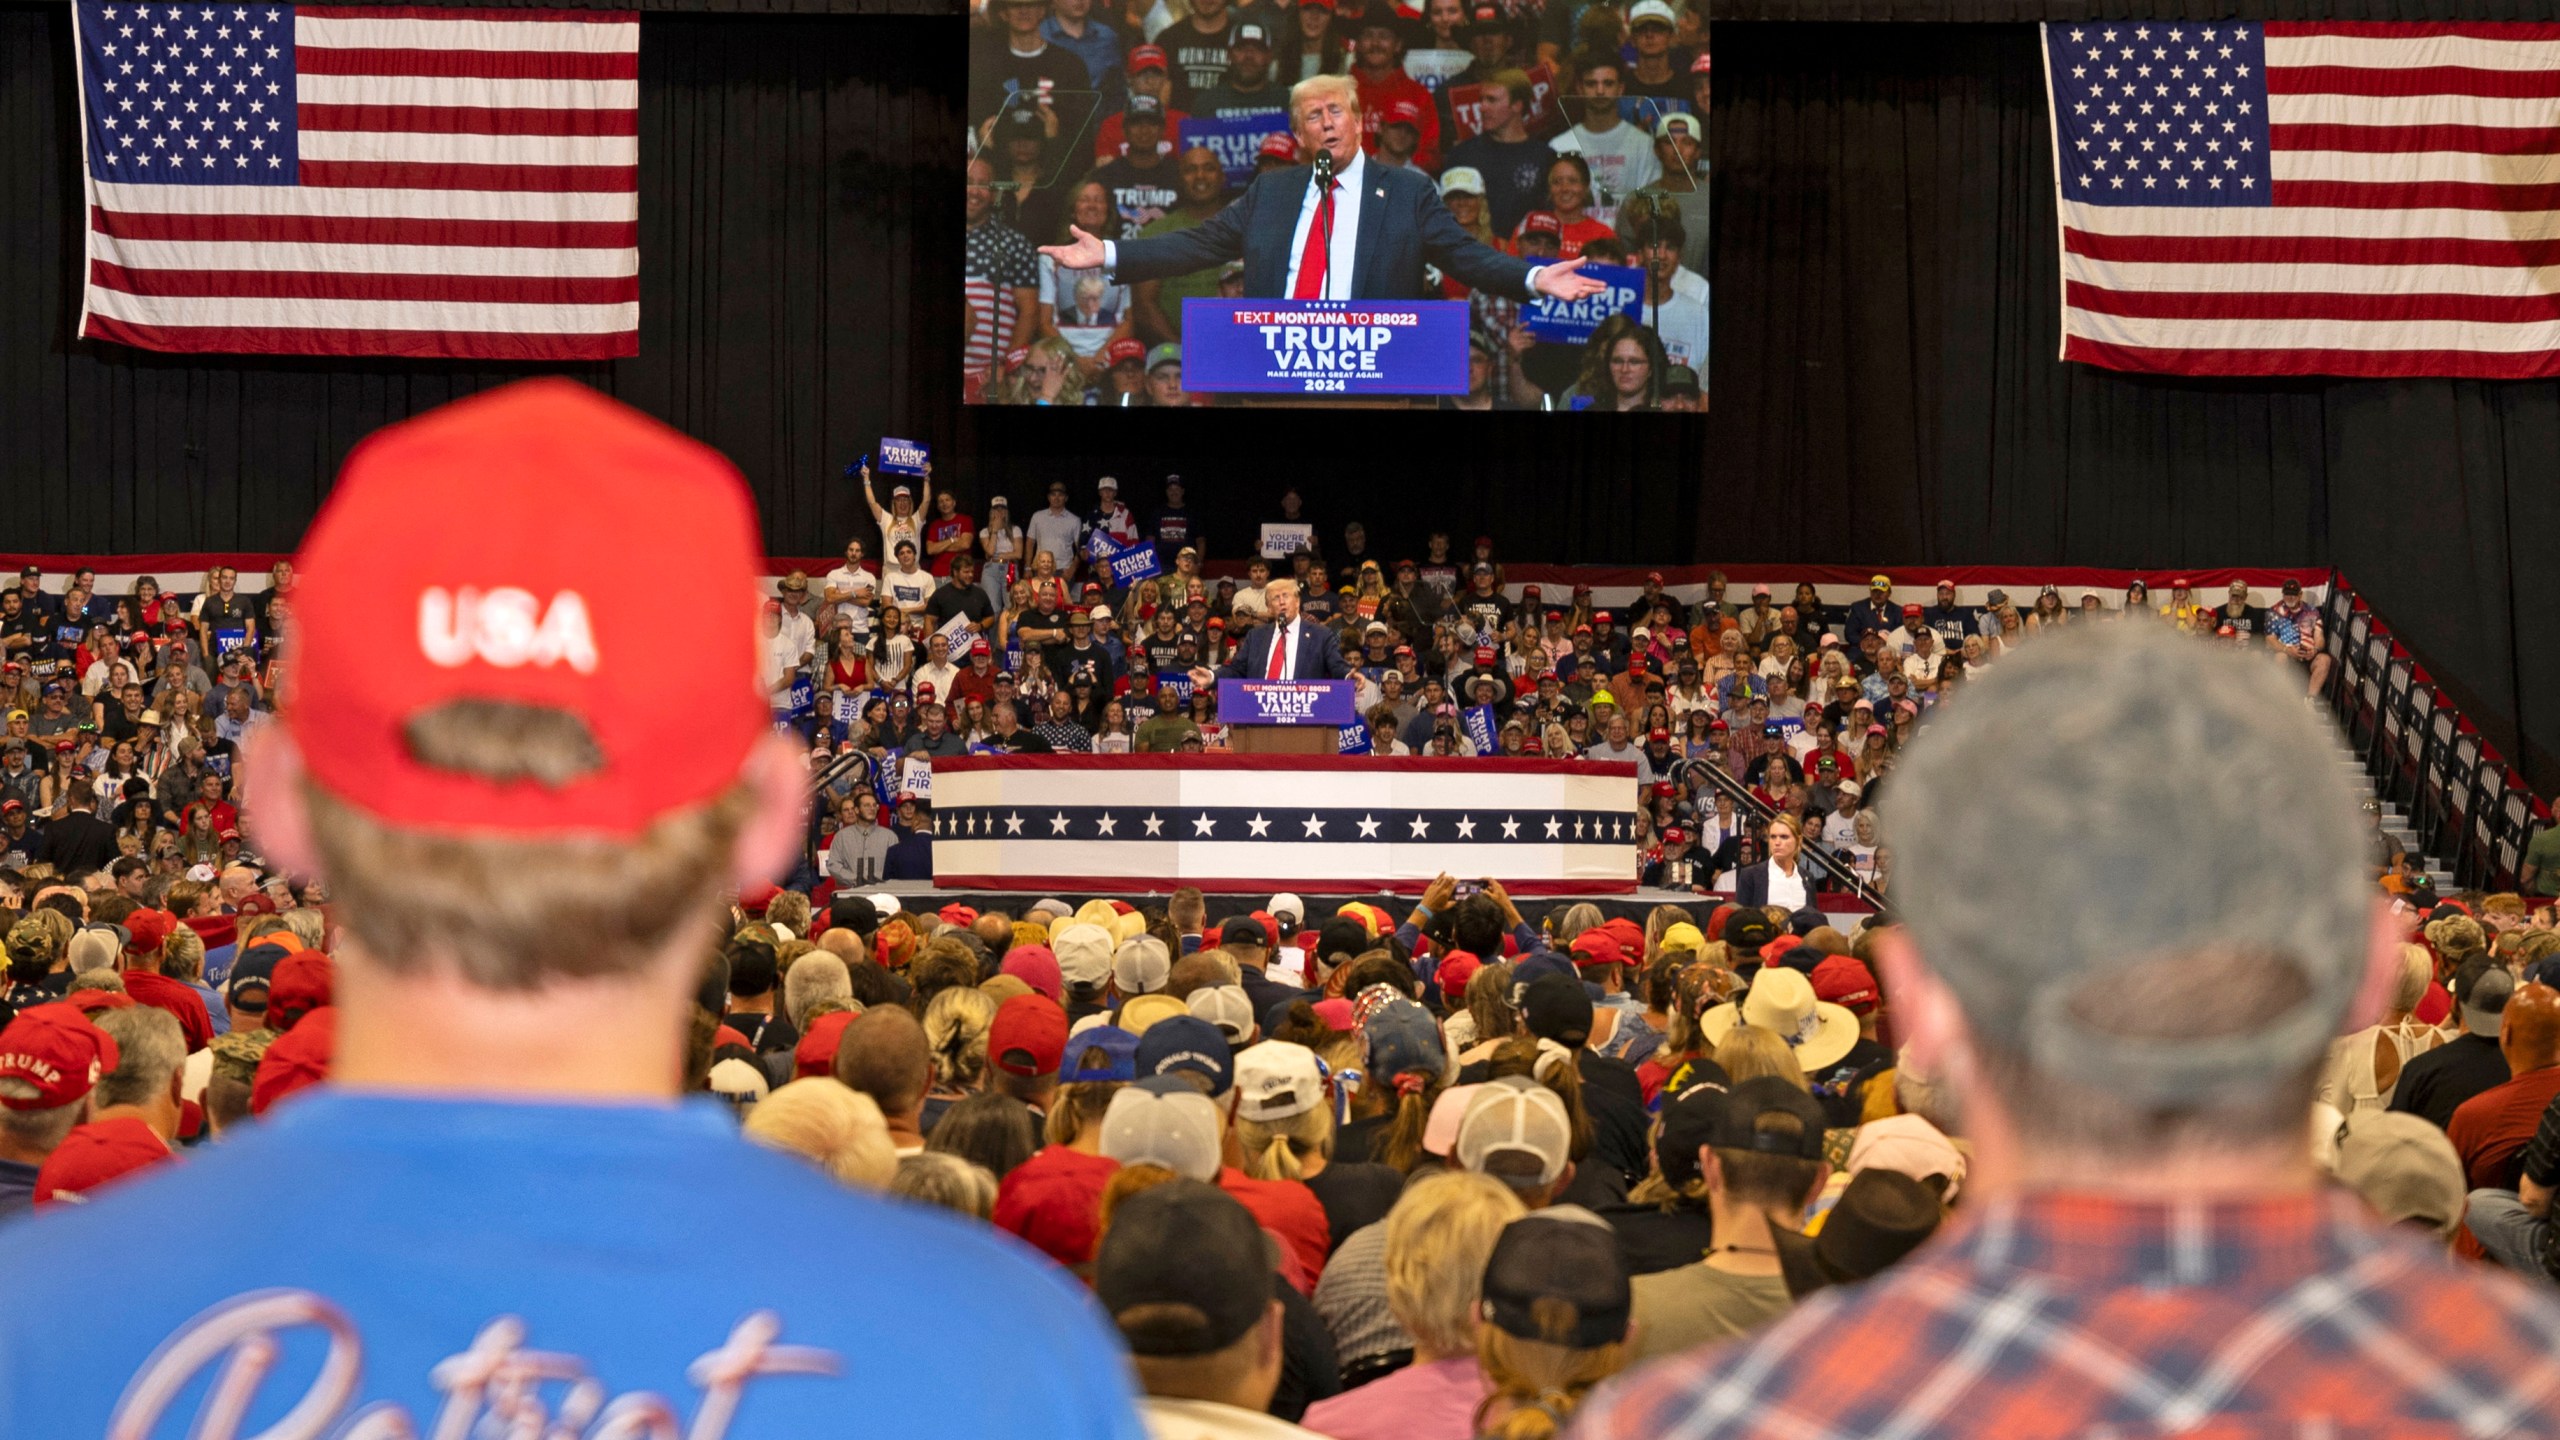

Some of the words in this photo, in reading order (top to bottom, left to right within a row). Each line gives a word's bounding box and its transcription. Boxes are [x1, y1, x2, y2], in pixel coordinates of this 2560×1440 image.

[1113, 187, 1178, 207] TRUMP
[1234, 311, 1270, 323] TEXT
[1274, 312, 1347, 324] MONTANA
[1350, 313, 1370, 324] TO
[1373, 313, 1417, 325] 88022
[1259, 325, 1392, 351] TRUMP
[1274, 350, 1376, 371] VANCE
[1291, 371, 1326, 379] AMERICA
[1304, 379, 1346, 391] 2024
[884, 446, 927, 458] TRUMP
[888, 454, 922, 466] VANCE
[1269, 533, 1305, 541] YOU'RE
[1112, 549, 1154, 571] TRUMP
[1119, 558, 1152, 576] VANCE
[417, 583, 600, 676] USA
[1151, 647, 1178, 657] MONTANA
[1262, 684, 1297, 692] MONTANA
[1255, 692, 1319, 704] TRUMP
[1125, 707, 1155, 717] TRUMP
[1262, 703, 1312, 713] VANCE
[1469, 716, 1482, 752] VANCE
[1475, 707, 1492, 753] TRUMP
[1697, 796, 1717, 812] US
